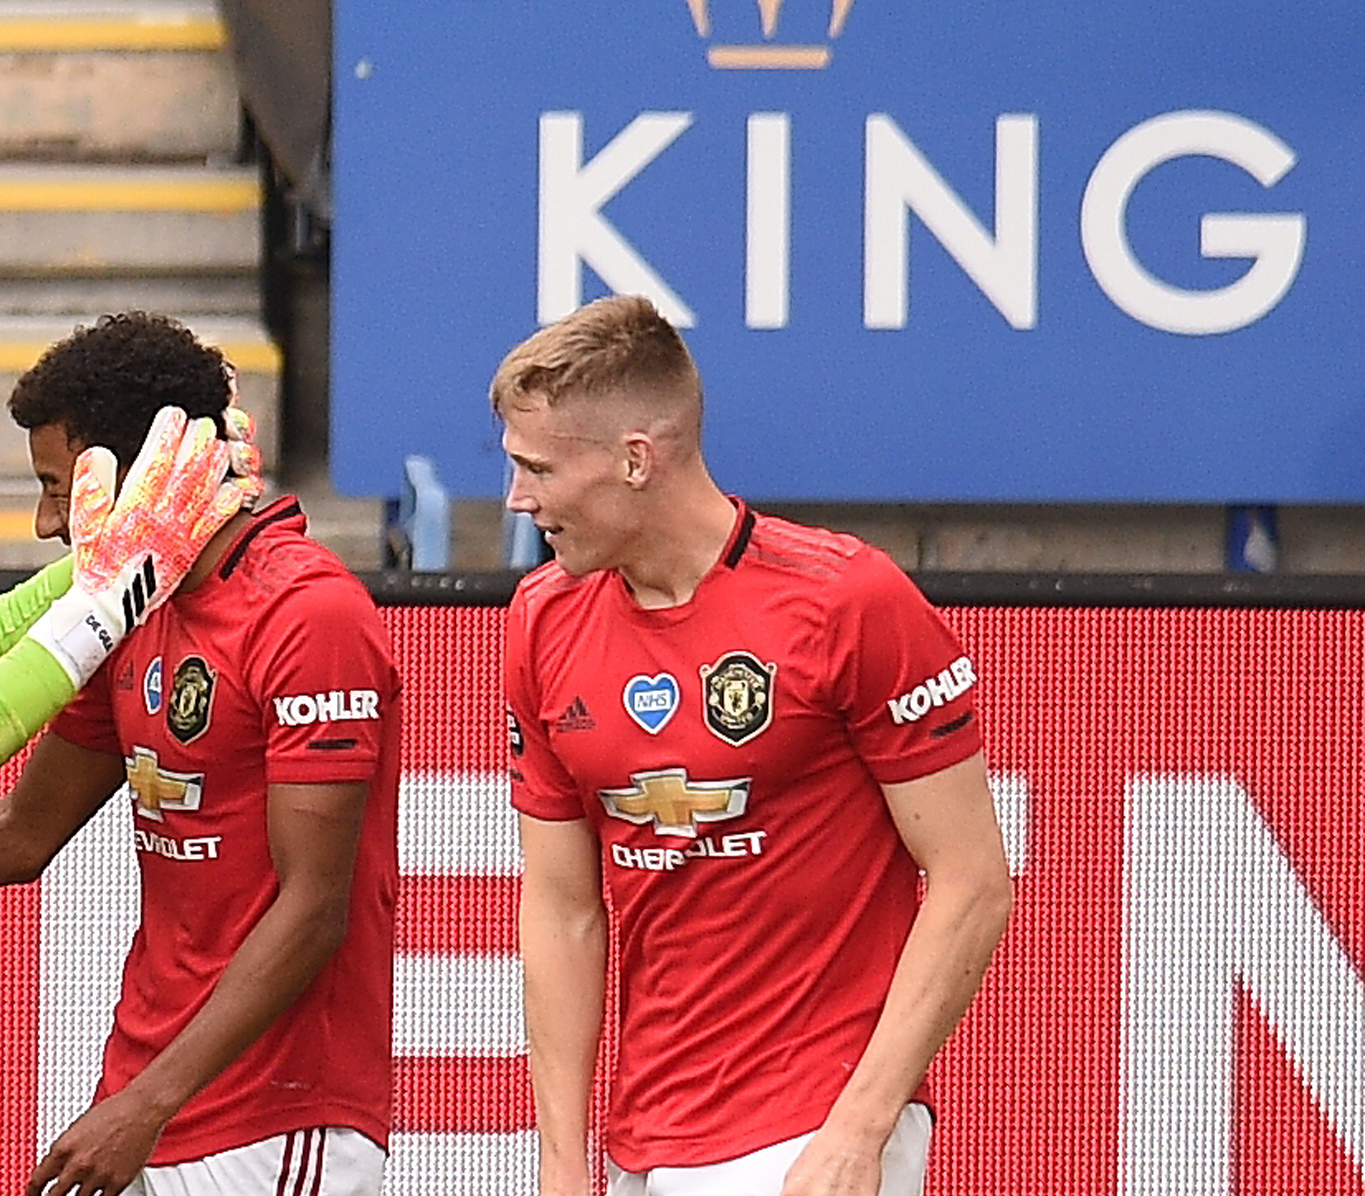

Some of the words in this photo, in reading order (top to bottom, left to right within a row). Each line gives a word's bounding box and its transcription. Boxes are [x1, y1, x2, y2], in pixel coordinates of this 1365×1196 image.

[538, 110, 1307, 335] KING
[272, 690, 379, 726] KOHLER
[636, 692, 667, 708] NHS
[887, 656, 977, 724] KOHLER
